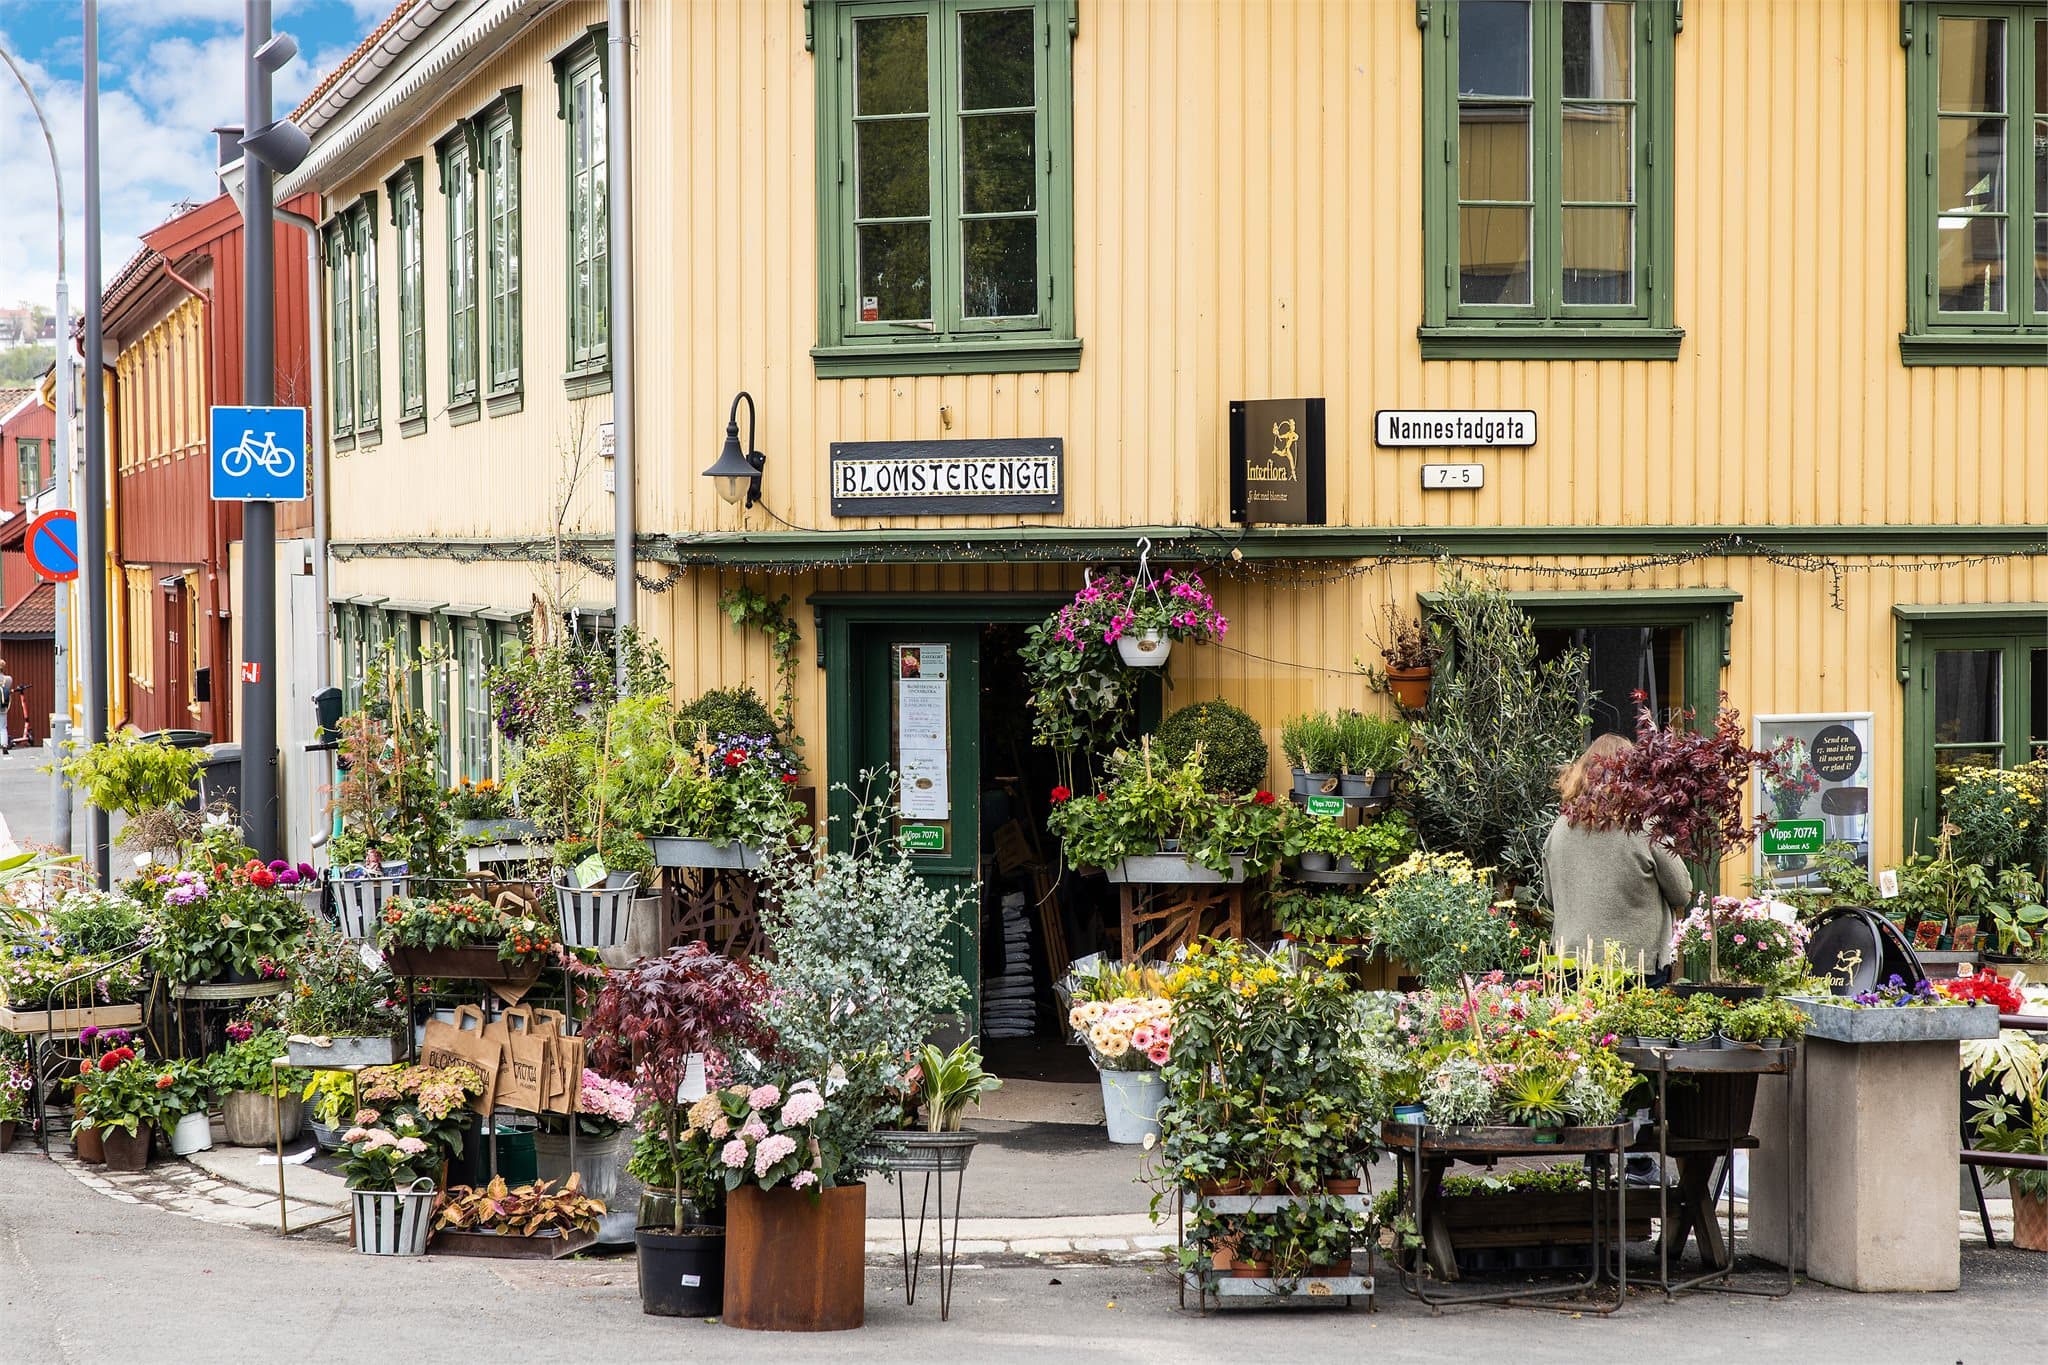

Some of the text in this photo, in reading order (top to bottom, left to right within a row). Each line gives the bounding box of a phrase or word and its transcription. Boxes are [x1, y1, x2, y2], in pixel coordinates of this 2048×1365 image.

[1390, 416, 1524, 443] Nannestadgata
[1247, 459, 1288, 481] Interflora
[842, 462, 1049, 492] BLOMSTERENGA
[1823, 736, 1840, 744] Send
[1840, 744, 1856, 752] klem
[1818, 754, 1827, 762] til
[1845, 753, 1854, 761] du
[1830, 763, 1845, 772] glad
[922, 830, 939, 839] 70774
[1769, 827, 1818, 841] Vipps 70774
